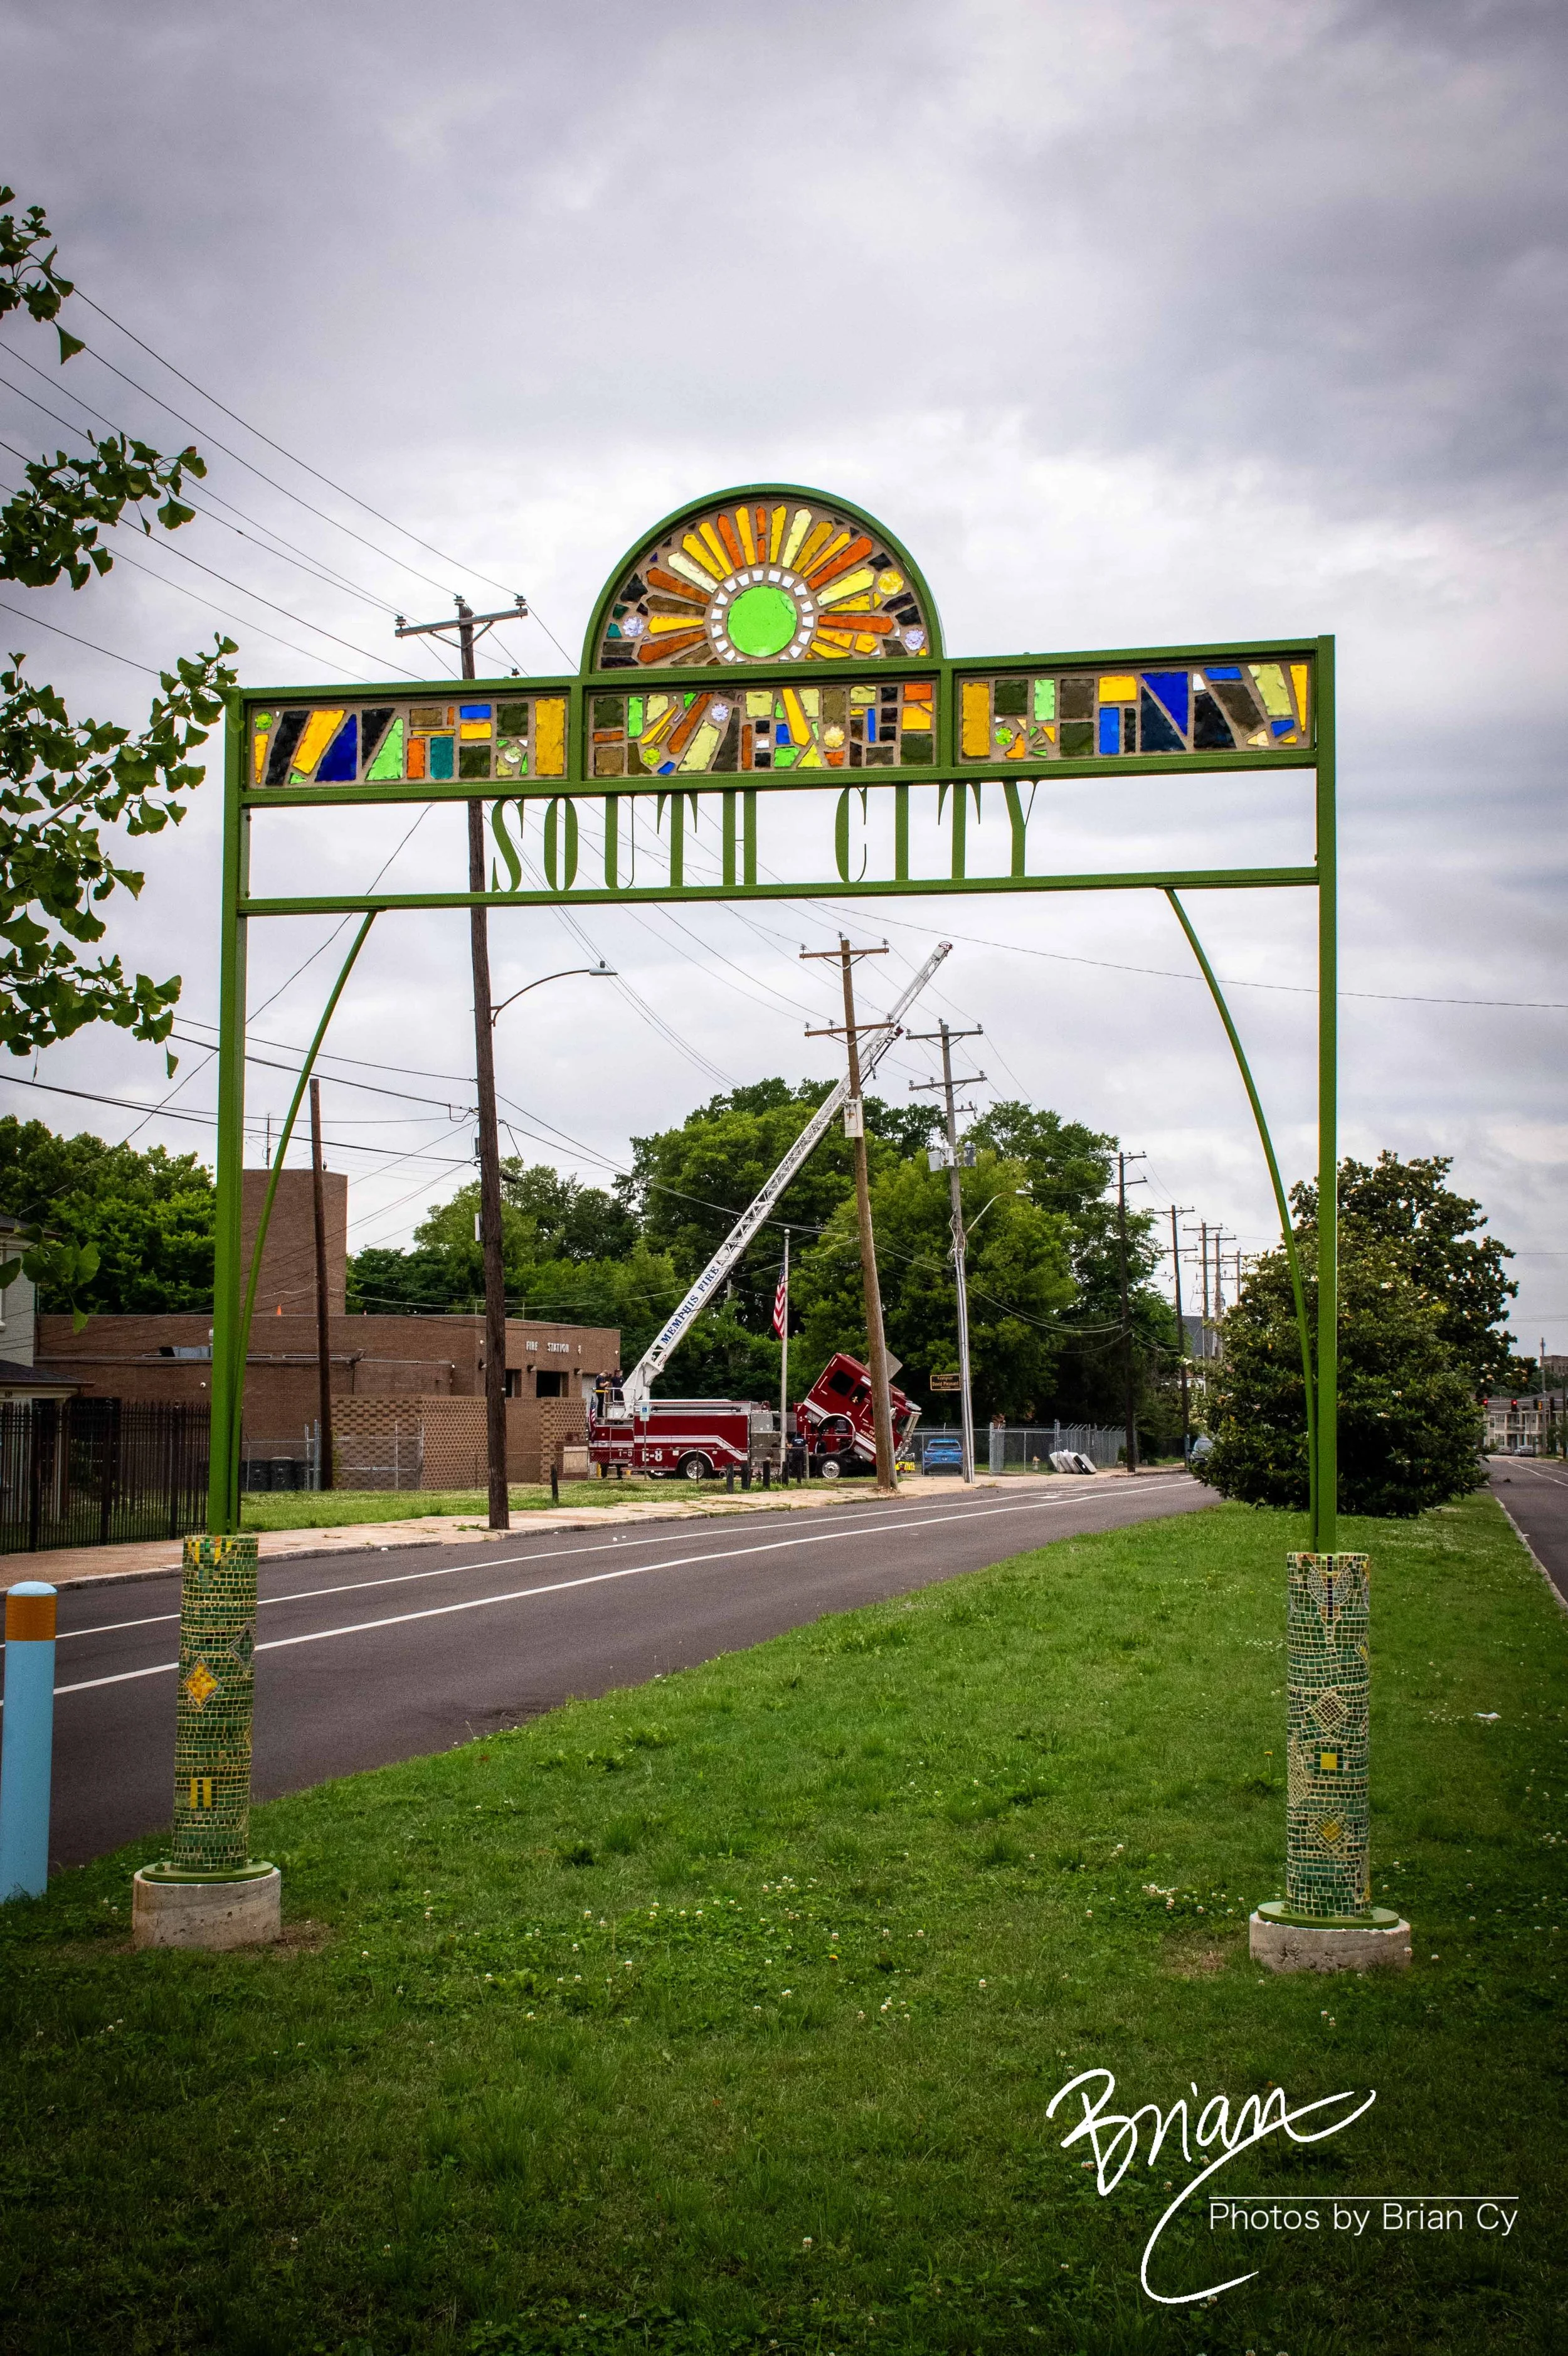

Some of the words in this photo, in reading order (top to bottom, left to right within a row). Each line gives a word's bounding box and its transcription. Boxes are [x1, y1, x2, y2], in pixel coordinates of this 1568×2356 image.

[491, 788, 756, 893] SOUTH
[835, 781, 1039, 883] CITY
[660, 1295, 699, 1345] MEMPHIS
[697, 1266, 719, 1293] FIRE
[526, 1340, 538, 1351] FIRE
[547, 1342, 569, 1353] STATION
[618, 1448, 632, 1457] T-5
[642, 1448, 662, 1462] E-8
